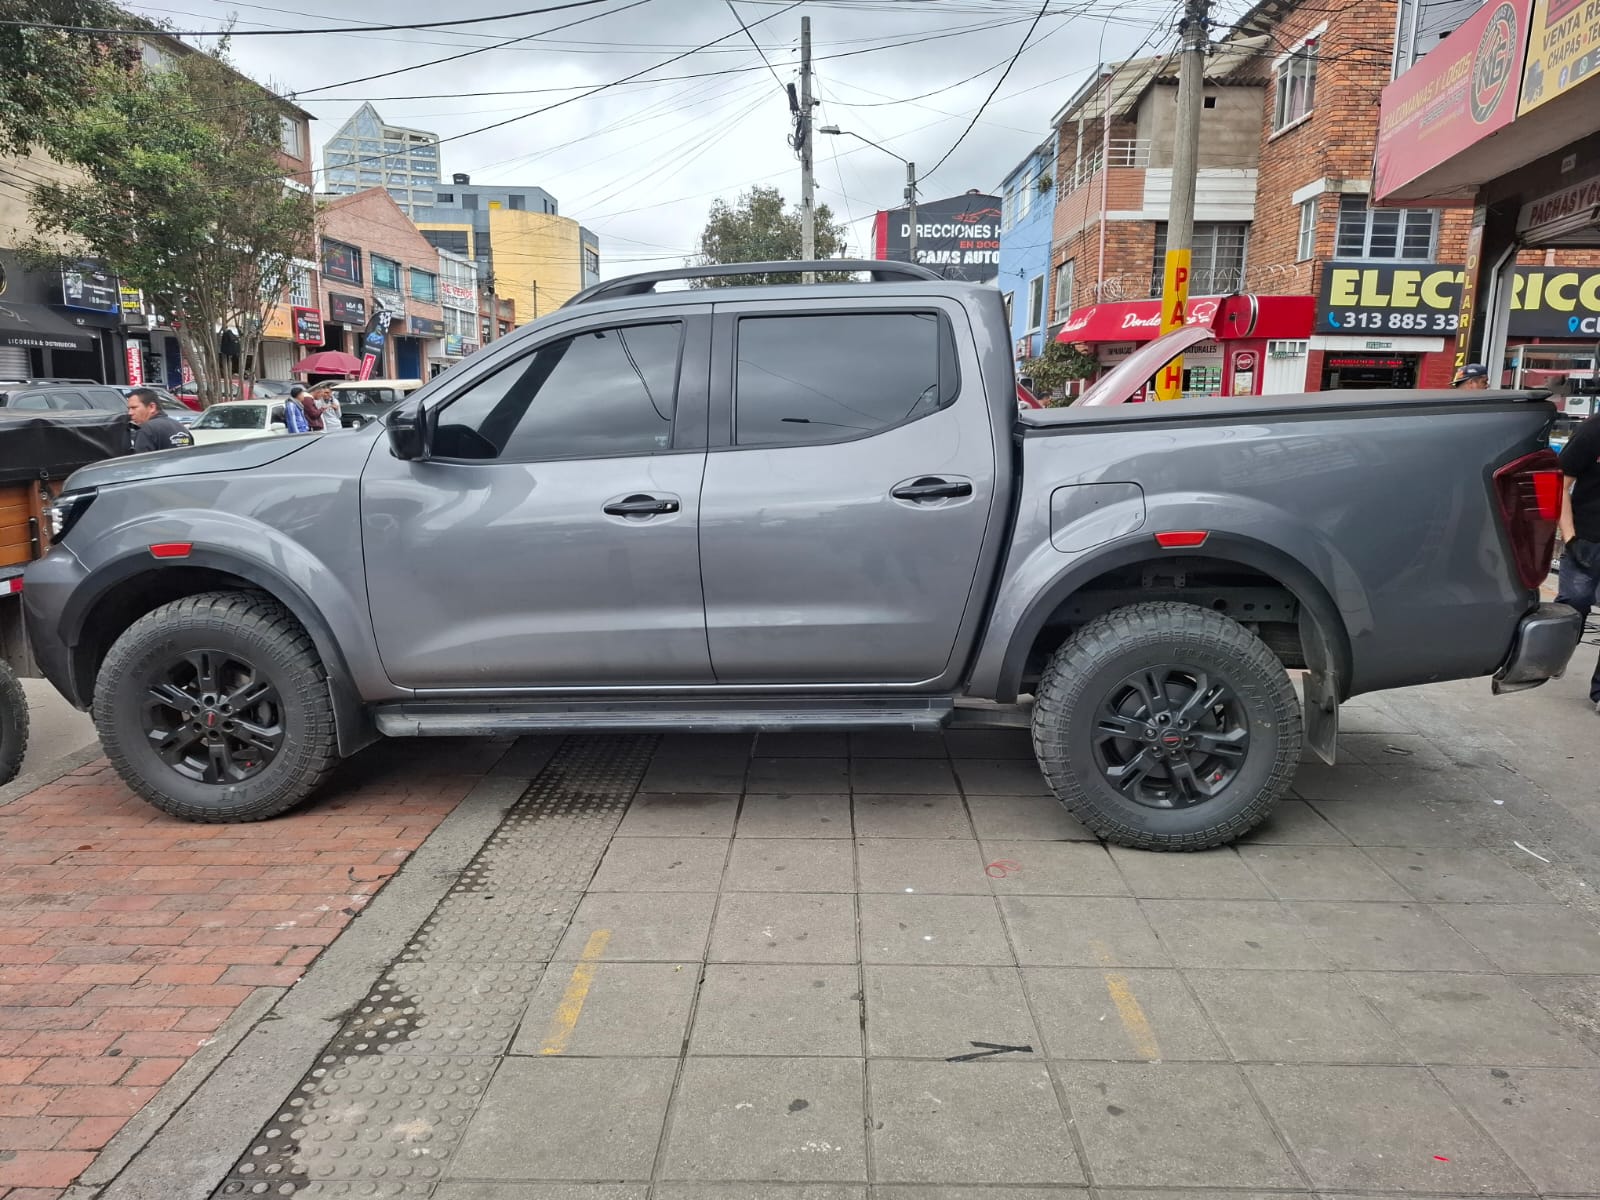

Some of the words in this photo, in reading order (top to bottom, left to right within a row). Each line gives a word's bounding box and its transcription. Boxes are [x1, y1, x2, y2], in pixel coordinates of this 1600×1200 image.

[1543, 12, 1580, 51] VENTA
[1547, 34, 1581, 70] CHAPAS
[901, 224, 991, 238] DRECCIONES
[1343, 312, 1382, 329] 313
[1388, 313, 1427, 330] 885
